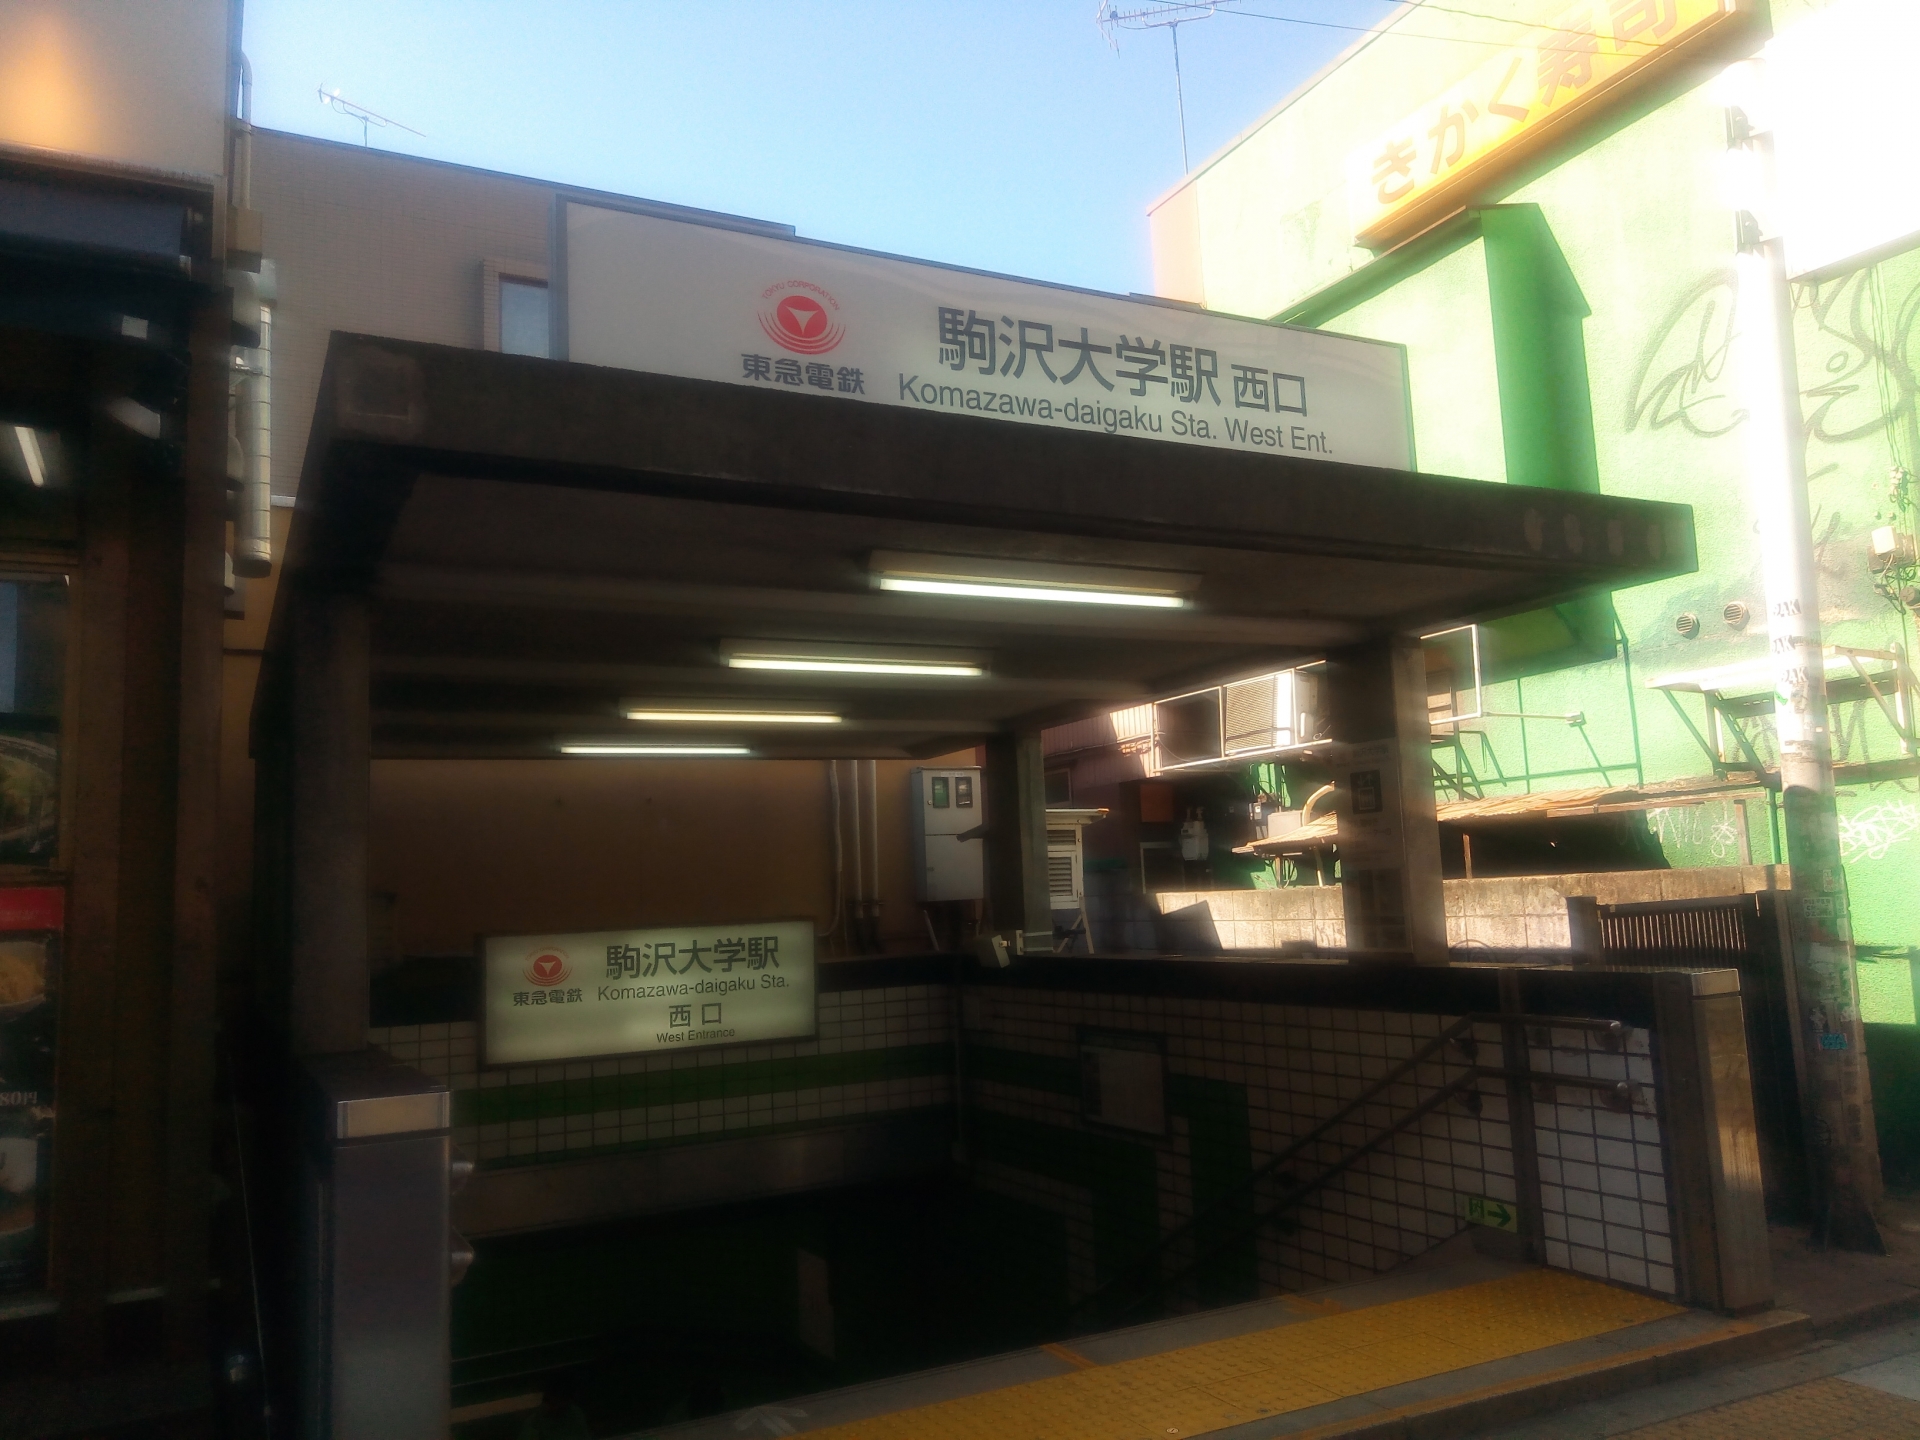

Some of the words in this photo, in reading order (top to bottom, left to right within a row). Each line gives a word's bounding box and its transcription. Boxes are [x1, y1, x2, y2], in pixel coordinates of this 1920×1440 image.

[1371, 0, 1677, 205] きかく寿司
[762, 281, 785, 300] TOKYU
[787, 280, 840, 311] CORPORATION
[741, 353, 866, 395] 東急電鉄
[937, 306, 1219, 407] 駒沢大学駅
[1231, 363, 1308, 418] 西口
[899, 373, 1163, 436] Komazawa-daigaku
[1171, 410, 1217, 442] Sta.
[1224, 417, 1284, 449] West
[1290, 425, 1333, 455] Ent.
[605, 935, 780, 981] 駒沢大学駅
[512, 988, 582, 1007] 東急電鉄
[597, 976, 756, 1001] Komazawa-daigaku
[760, 974, 790, 990] Sta.
[668, 1002, 723, 1029] 西口
[656, 1032, 685, 1044] West
[687, 1028, 735, 1042] Entrance
